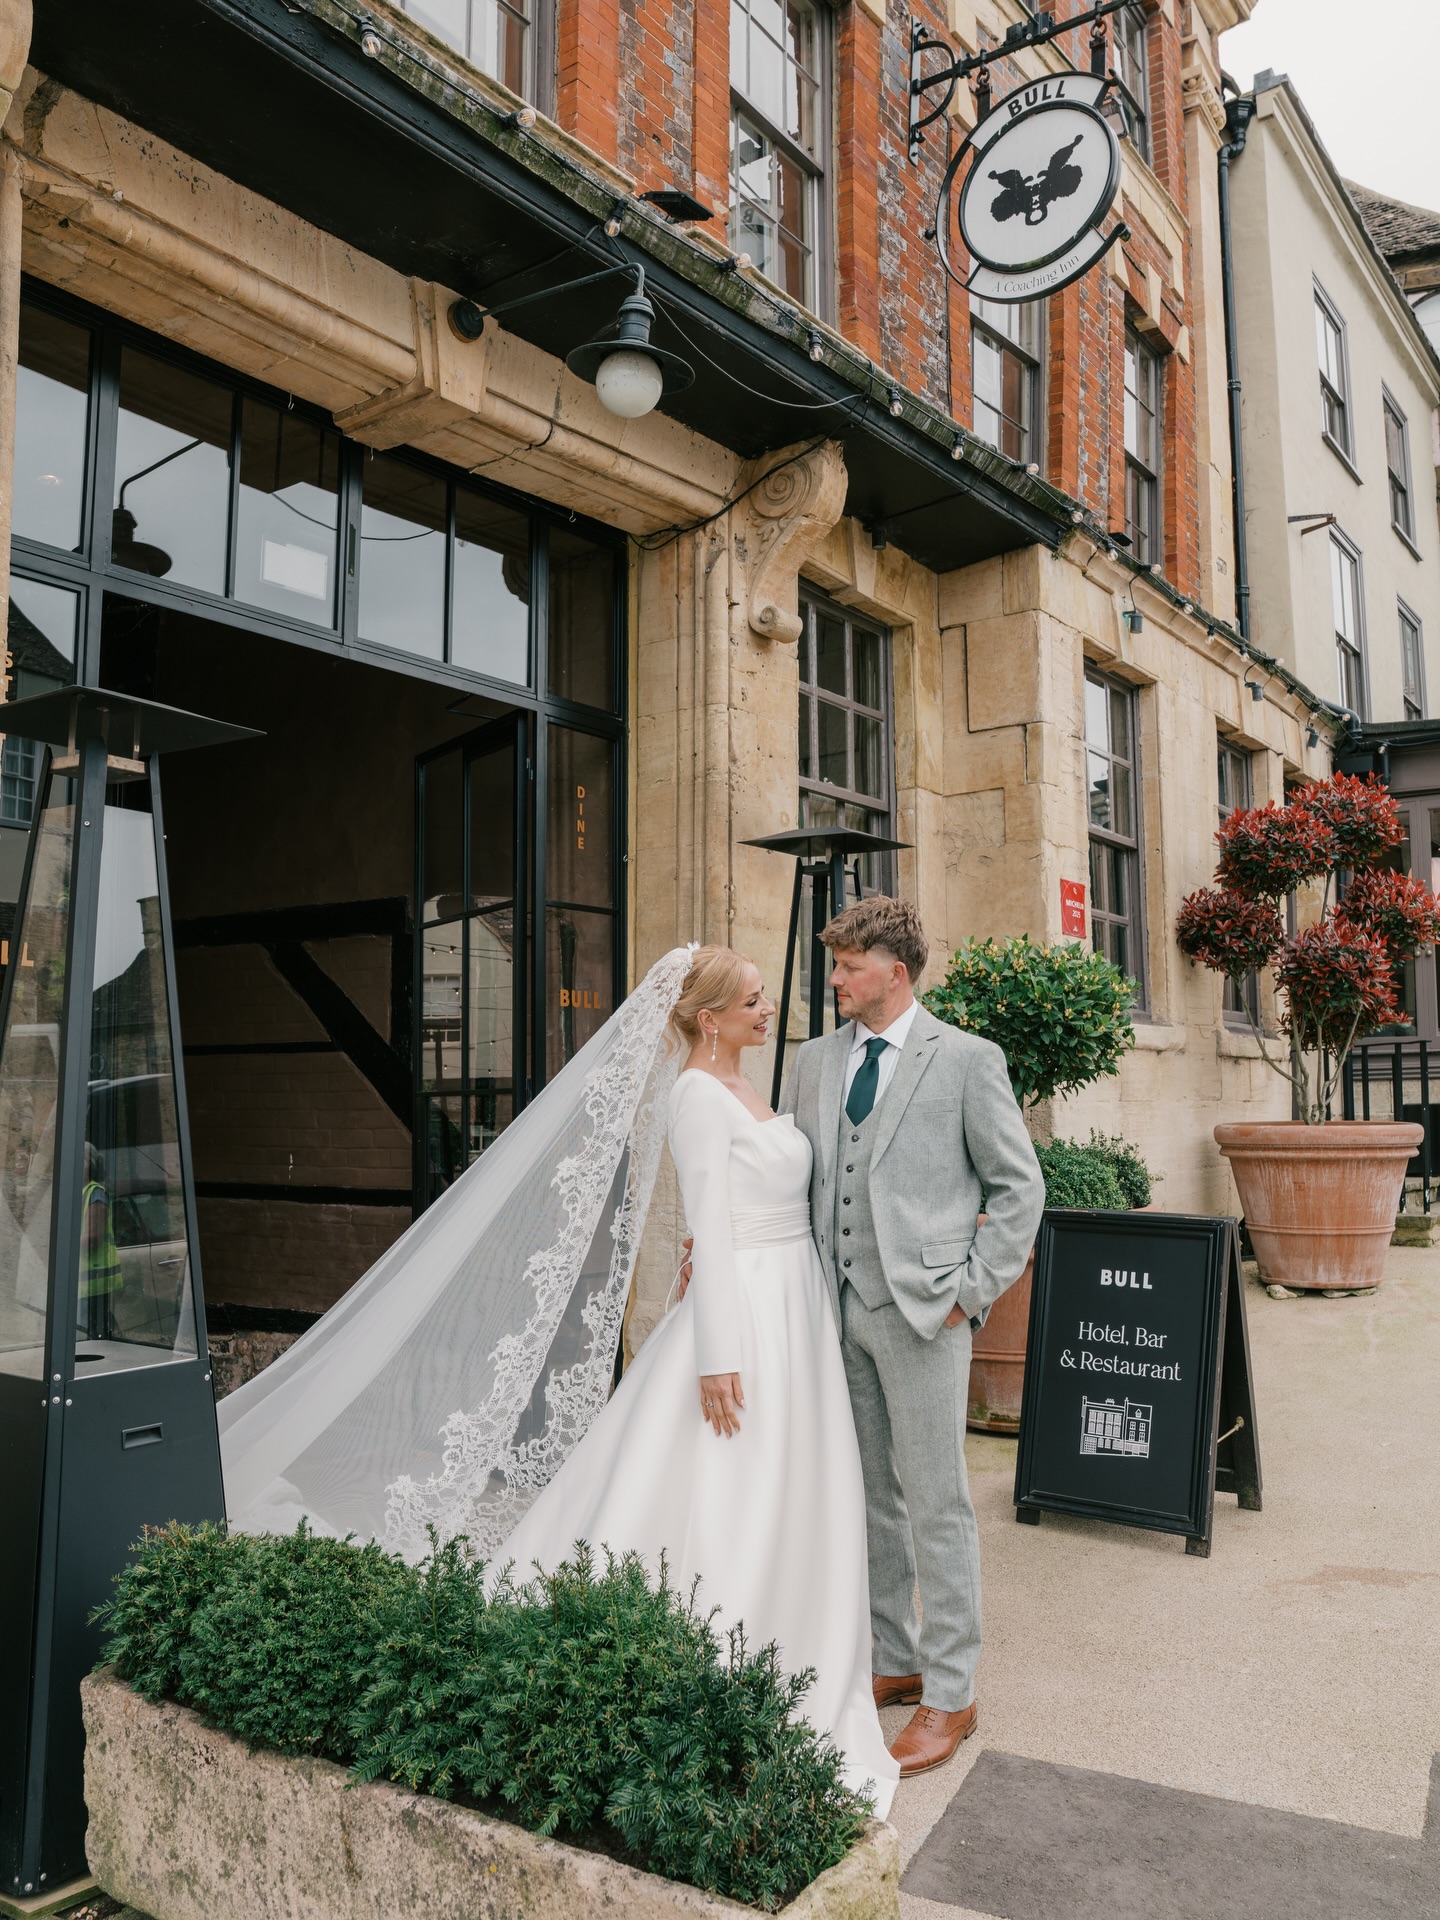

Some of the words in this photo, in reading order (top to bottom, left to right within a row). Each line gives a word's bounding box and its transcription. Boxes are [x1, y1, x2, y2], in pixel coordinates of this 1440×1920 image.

[1007, 80, 1066, 118] BULL
[1003, 270, 1058, 293] Coaching
[1060, 255, 1080, 274] Inn
[576, 785, 586, 850] DINE
[559, 989, 602, 1009] BULL
[1100, 1268, 1153, 1290] BULL
[1077, 1321, 1129, 1347] Hotel,
[1134, 1327, 1167, 1349] Bar
[1060, 1349, 1077, 1369] &
[1080, 1351, 1182, 1381] Restaurant
